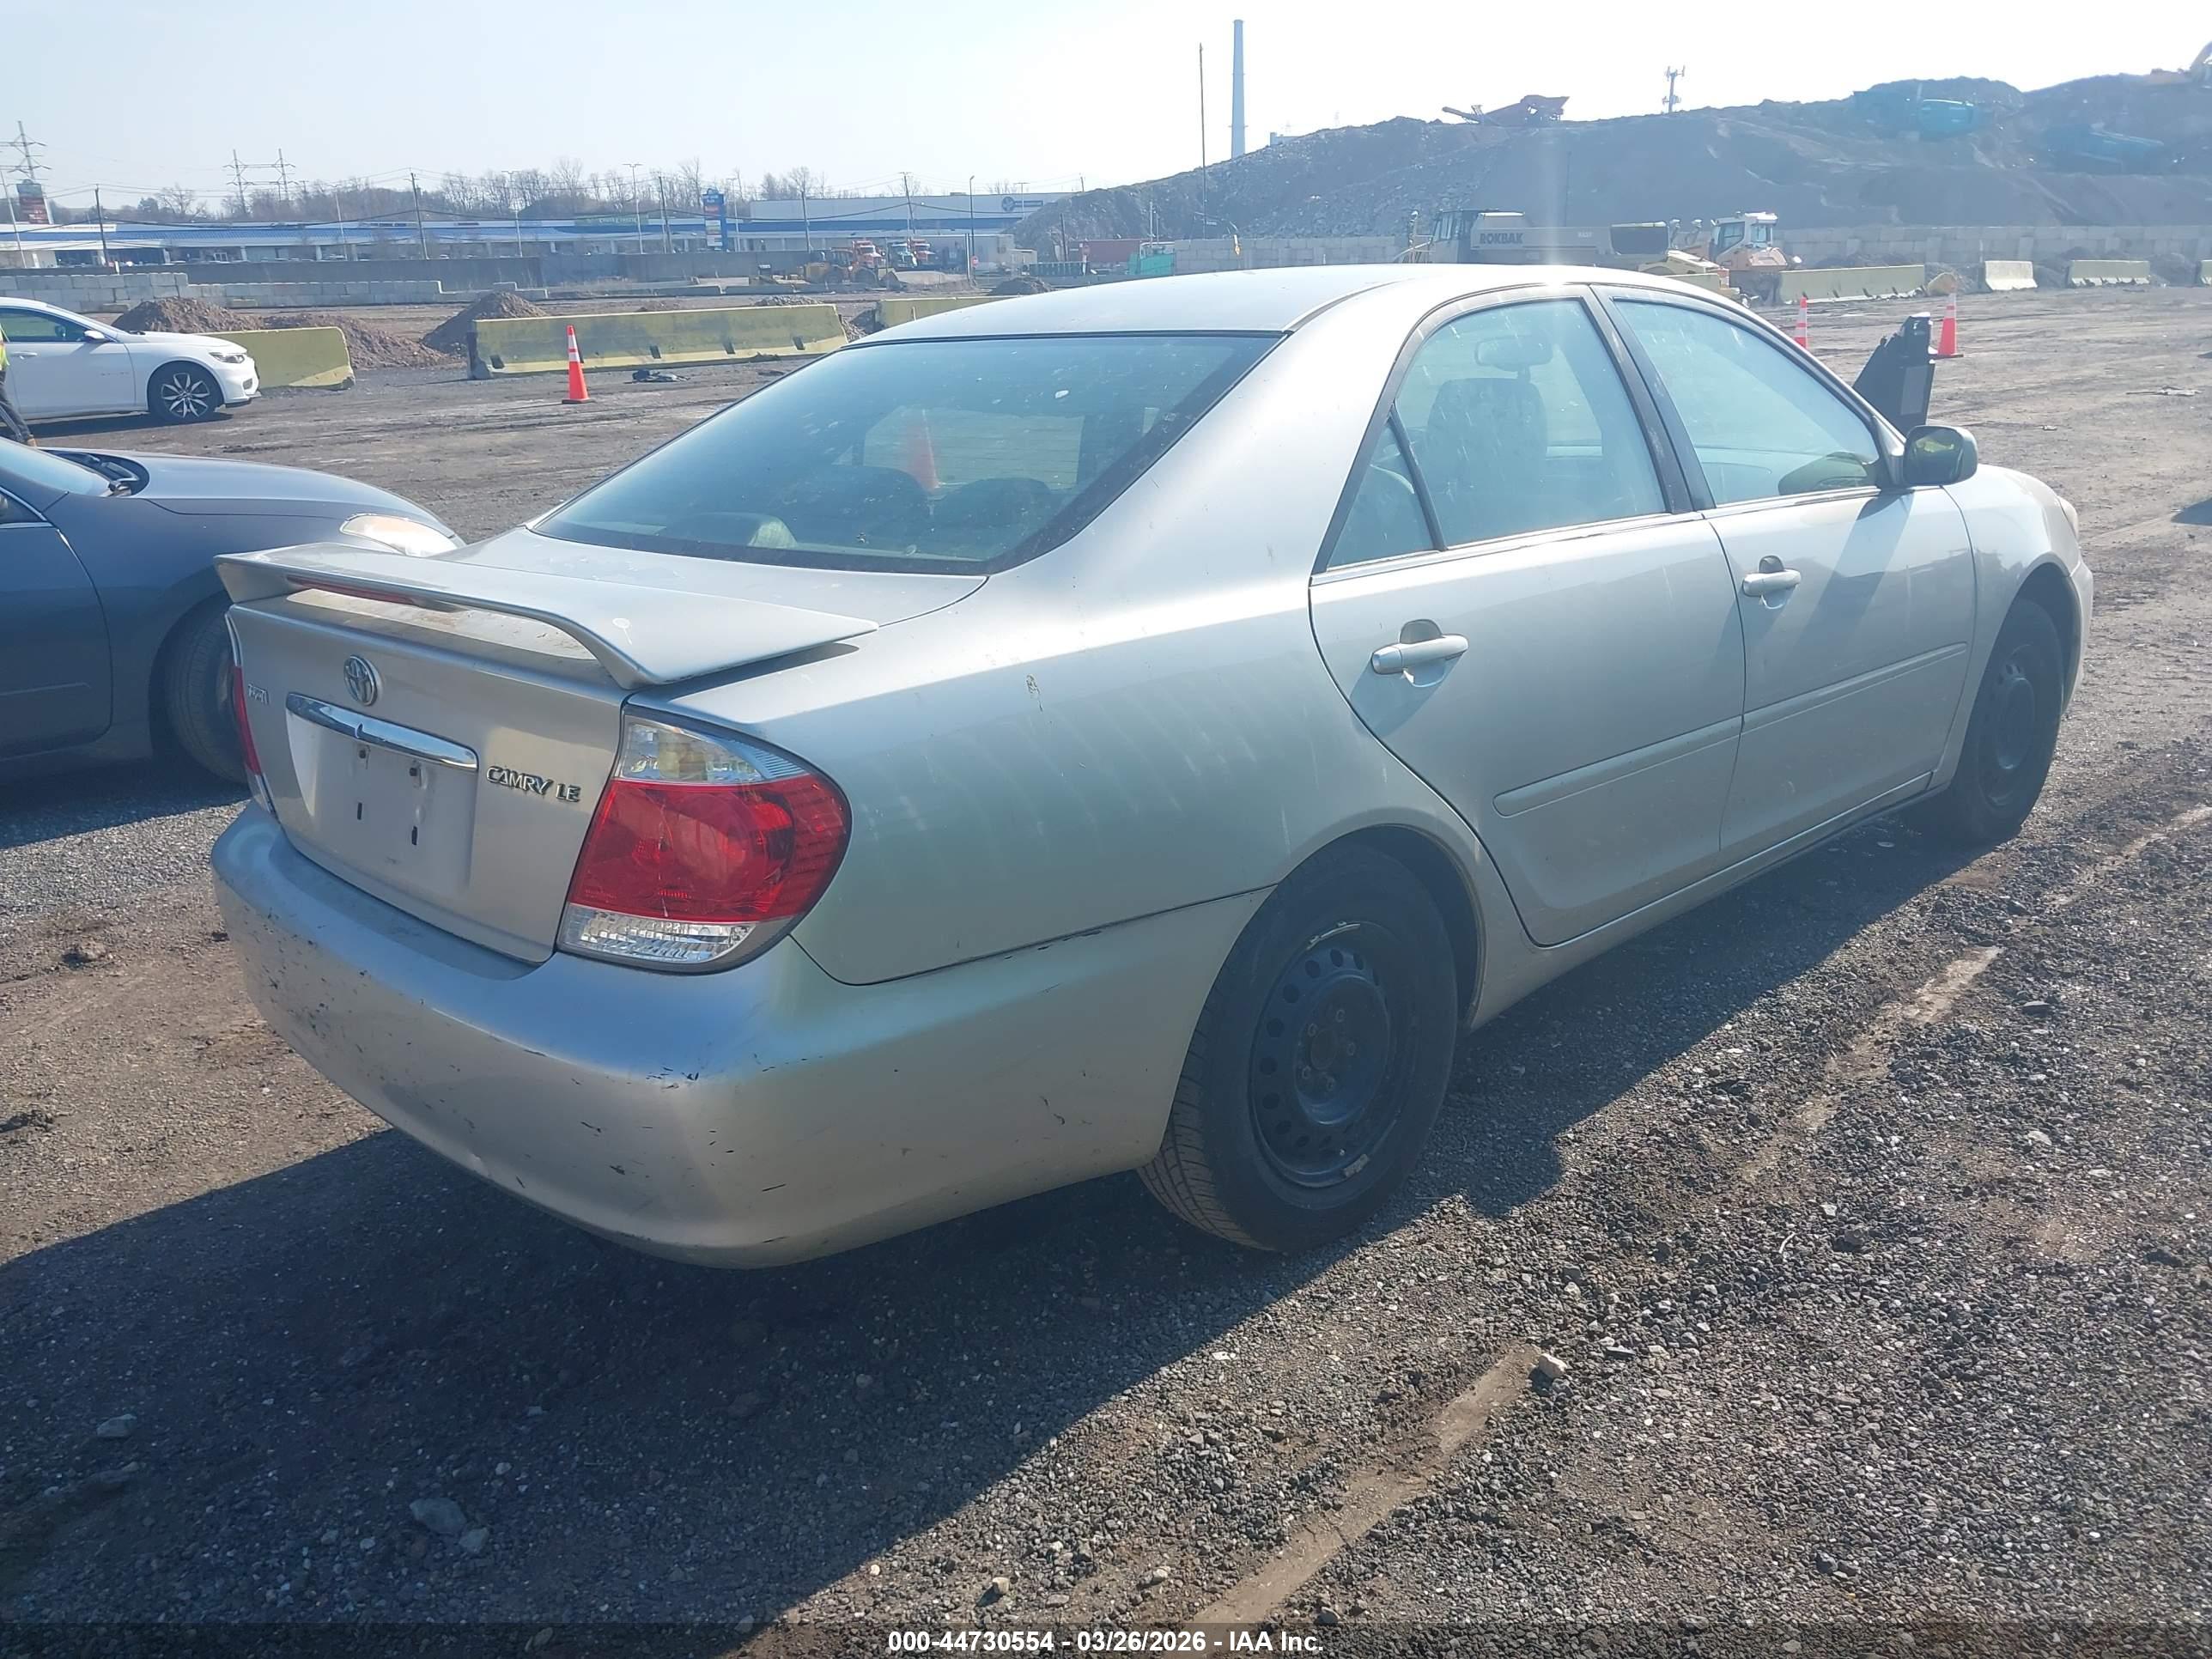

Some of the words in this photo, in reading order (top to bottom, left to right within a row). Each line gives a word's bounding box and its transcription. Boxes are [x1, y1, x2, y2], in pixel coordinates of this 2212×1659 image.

[1479, 232, 1523, 245] ROKBAK
[486, 765, 554, 795] CAMRY
[556, 783, 581, 803] LE
